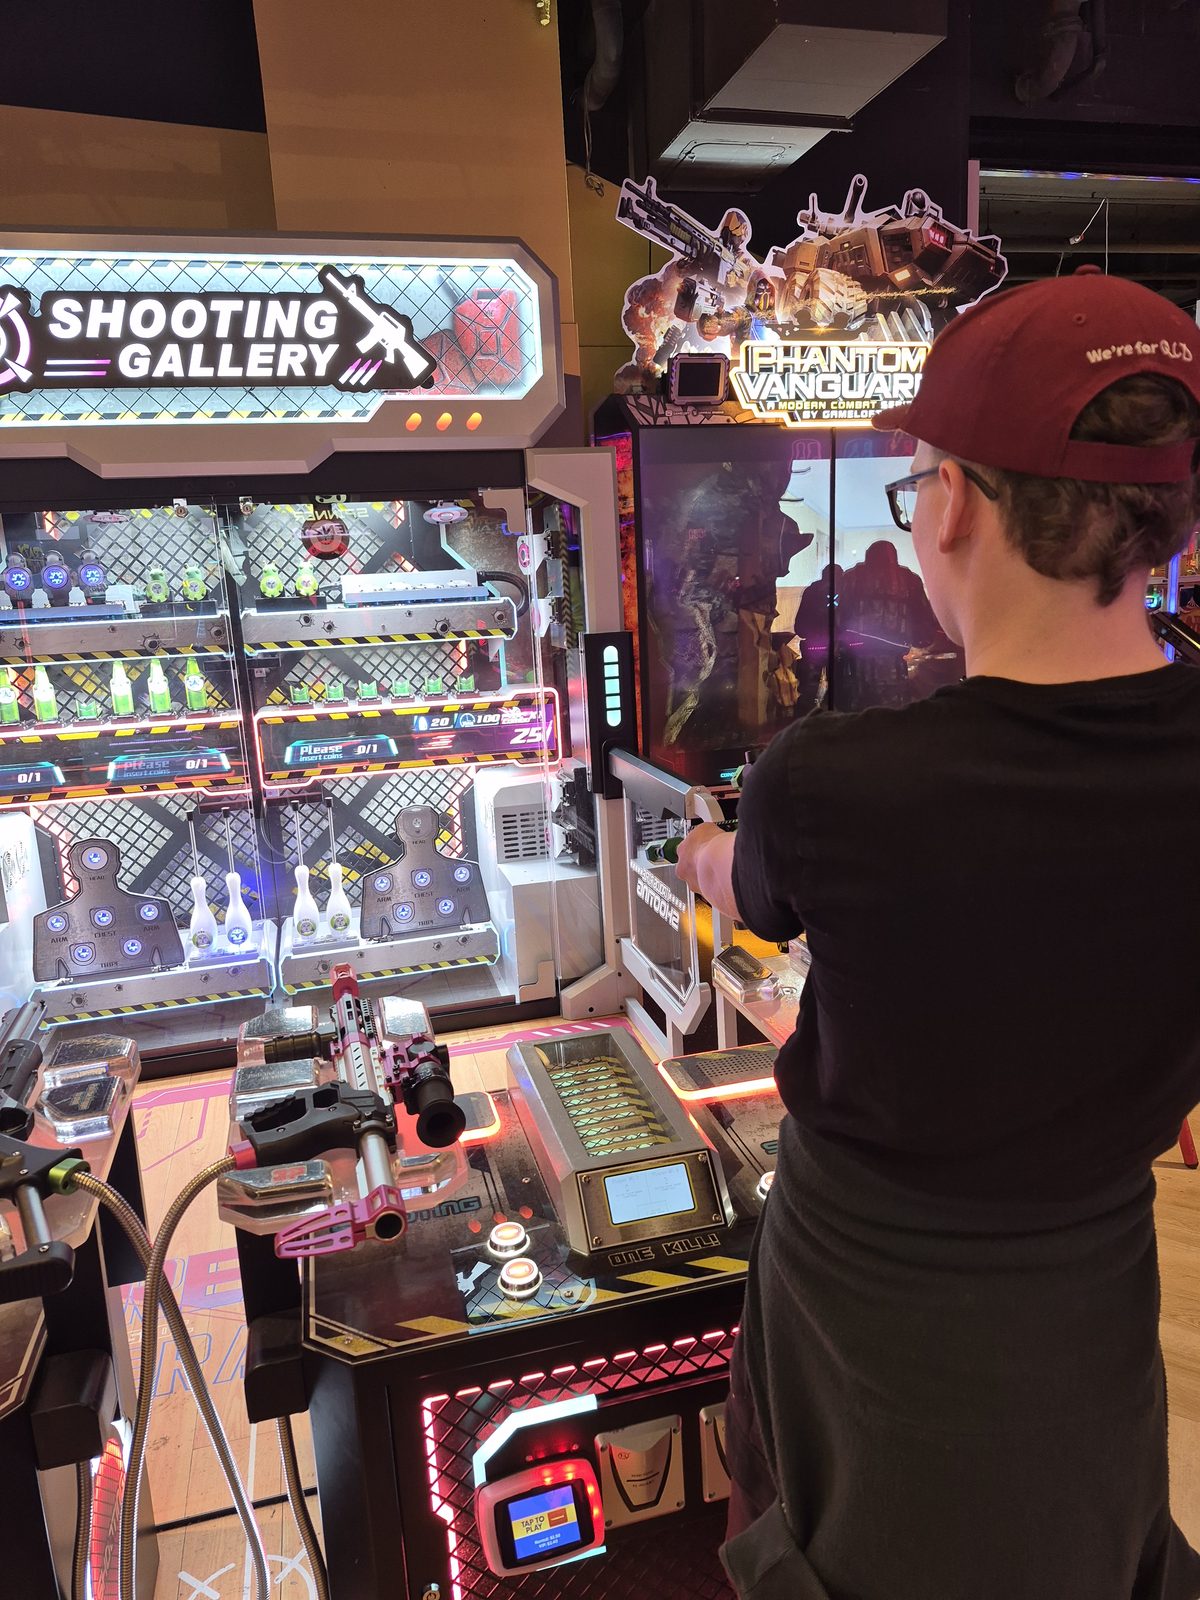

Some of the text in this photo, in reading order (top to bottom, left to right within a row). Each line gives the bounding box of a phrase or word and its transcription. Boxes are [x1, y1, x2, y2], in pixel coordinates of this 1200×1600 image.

[48, 298, 339, 339] SHOOTING
[1086, 344, 1133, 363] We're
[1134, 341, 1159, 355] for
[118, 343, 339, 379] GALLERY
[752, 346, 928, 373] PHANTOM
[740, 372, 923, 400] VANGUAR
[778, 400, 826, 410] MODERN
[830, 400, 877, 410] COMBAT
[802, 411, 818, 419] BY
[430, 717, 450, 727] 20
[477, 714, 500, 724] 100
[300, 744, 377, 756] Please 0/1
[300, 752, 343, 762] insert coins
[185, 759, 208, 770] 0/1
[17, 772, 41, 784] 0/1
[94, 930, 117, 939] CHEST
[143, 925, 160, 933] ARM
[50, 936, 69, 944] ARM
[607, 1233, 721, 1267] ONE KILL!
[521, 1515, 545, 1528] TAP TO
[525, 1523, 543, 1534] PLAY
